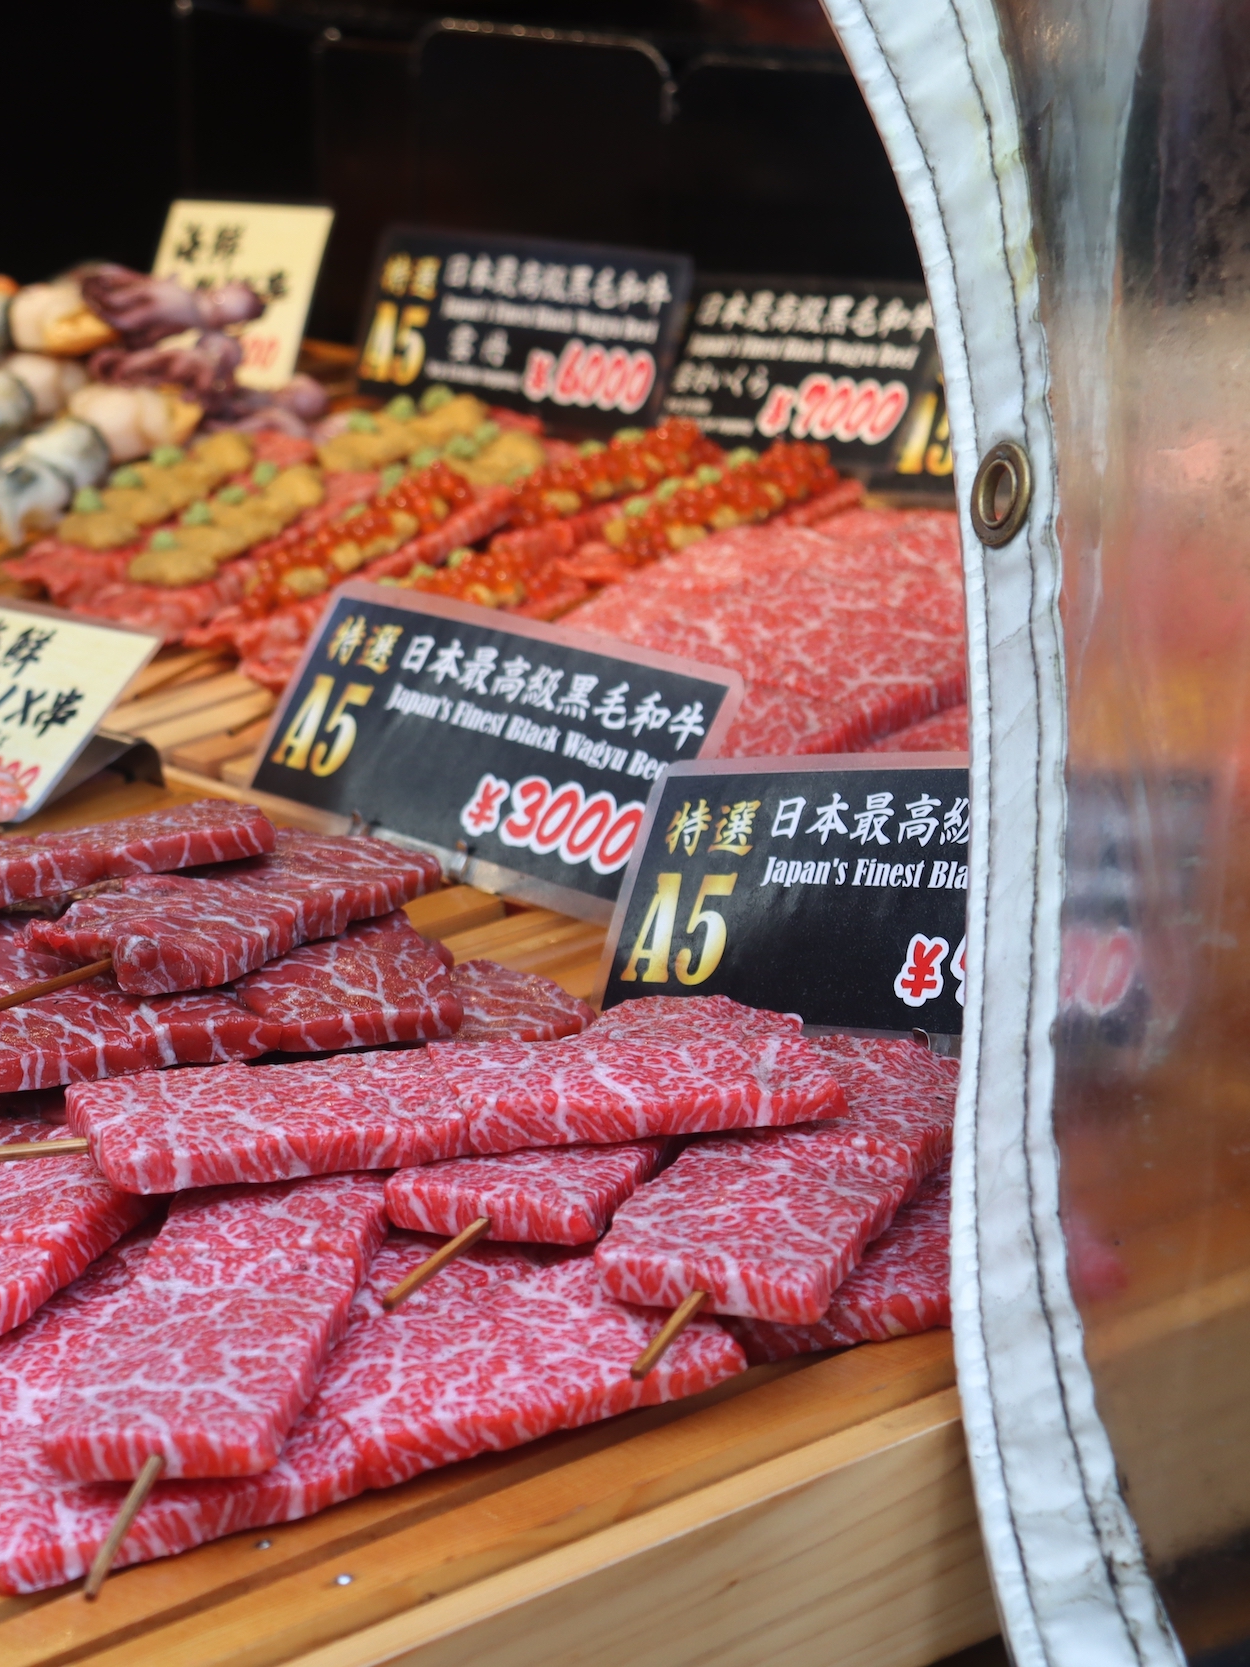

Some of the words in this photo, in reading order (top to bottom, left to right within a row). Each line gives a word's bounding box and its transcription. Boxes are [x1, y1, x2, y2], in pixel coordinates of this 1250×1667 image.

[358, 301, 431, 386] A5
[326, 615, 404, 676] 特選
[400, 635, 705, 751] 日本最高級黒毛和牛
[271, 674, 375, 779] A5
[384, 683, 452, 723] Japan's
[450, 700, 509, 738] Finest
[504, 714, 562, 752] Black
[561, 729, 629, 772] Wagyu
[626, 749, 670, 782] Bee
[461, 774, 646, 876] ¥3000
[665, 799, 761, 857] 特選
[761, 856, 848, 888] Japan's
[852, 858, 925, 888] Finest
[928, 860, 968, 889] Bla
[620, 873, 738, 987] A5
